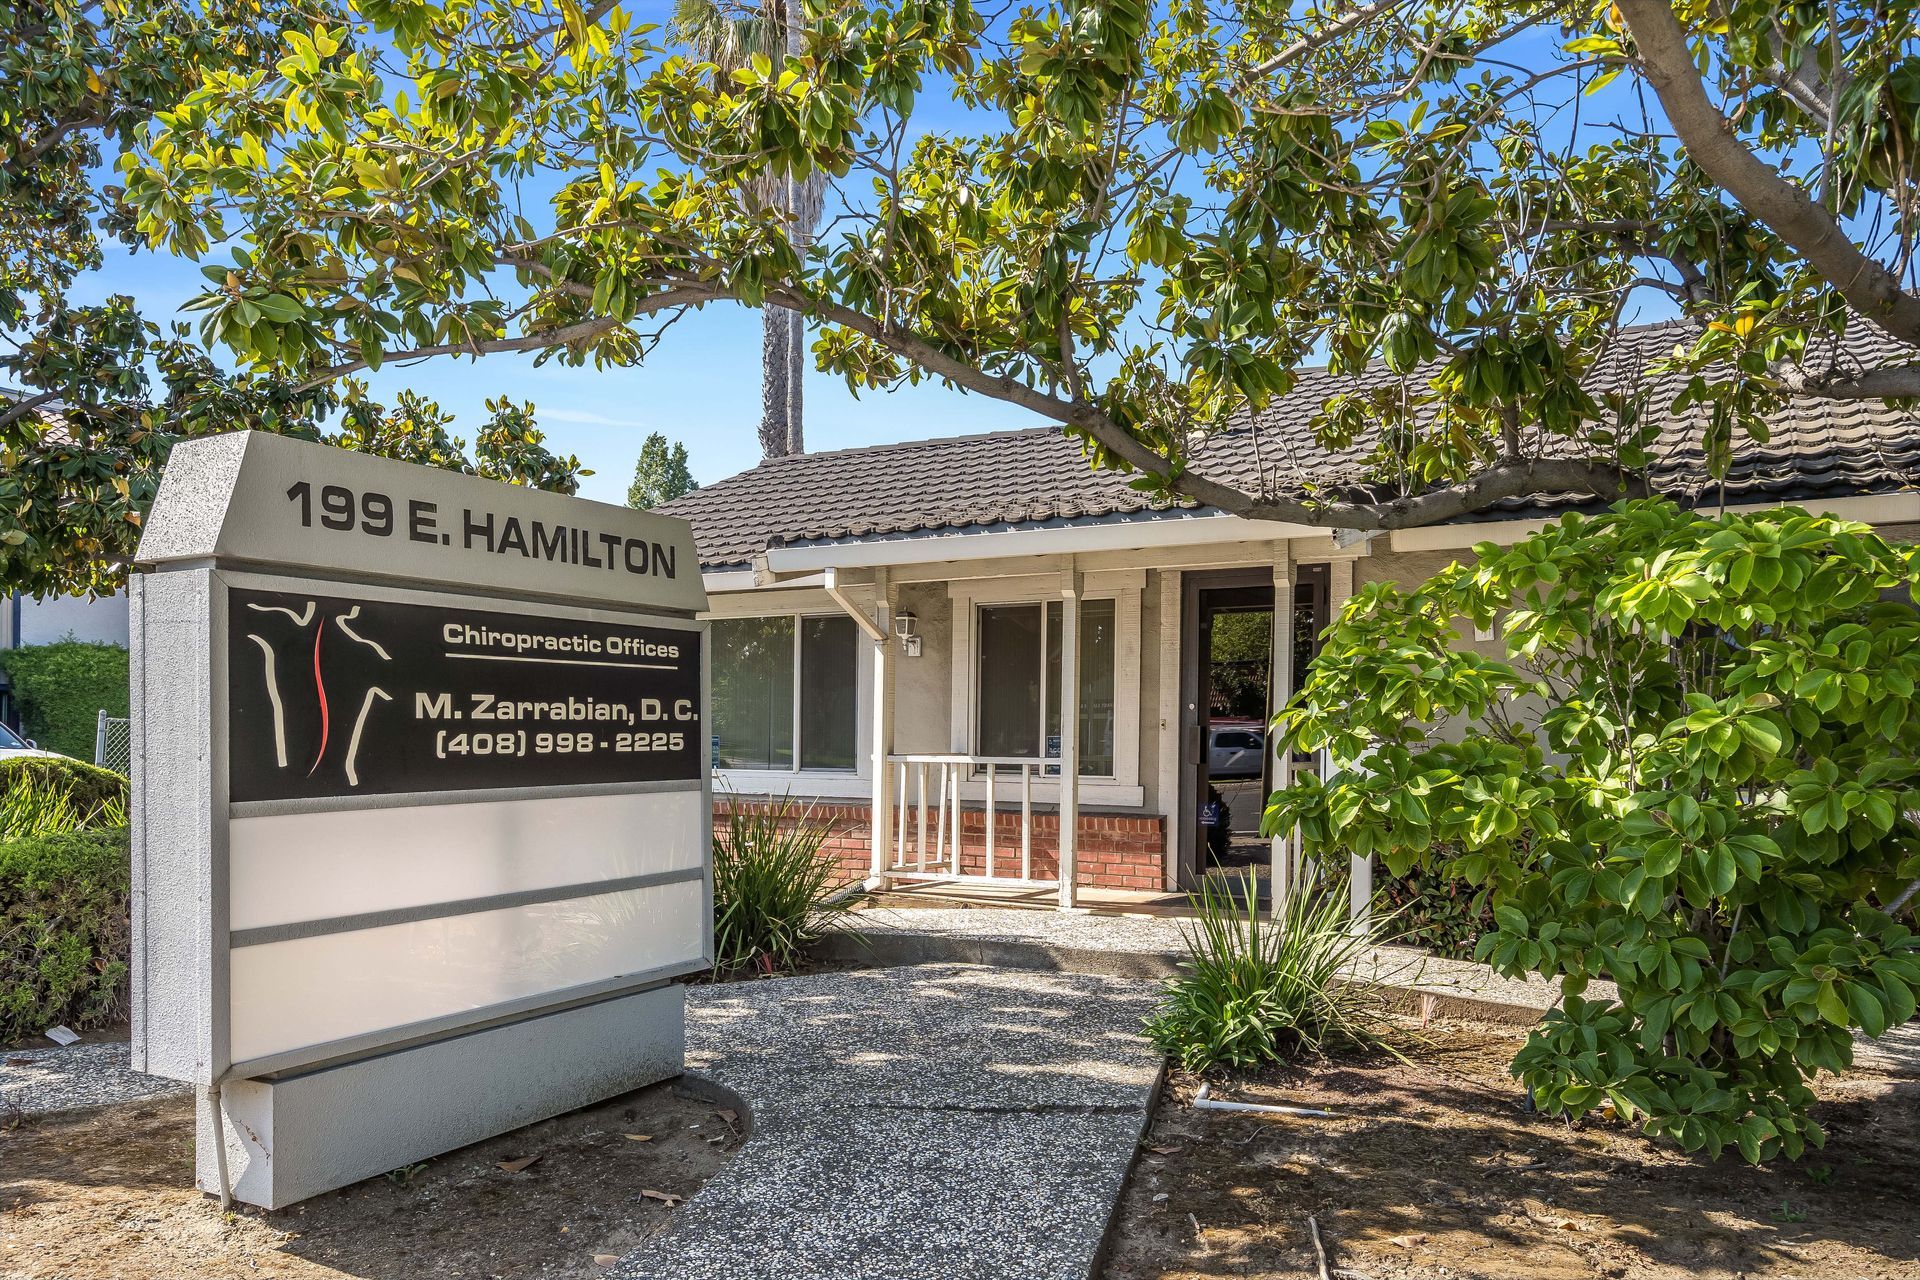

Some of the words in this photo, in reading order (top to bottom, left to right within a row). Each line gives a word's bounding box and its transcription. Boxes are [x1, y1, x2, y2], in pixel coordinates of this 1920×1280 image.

[286, 481, 394, 537] 199
[409, 499, 450, 546] E.
[463, 508, 676, 579] HAMILTON
[443, 623, 601, 652] Chiropractic
[606, 636, 679, 658] Offices
[415, 692, 462, 719] M.
[471, 694, 635, 726] Zarrabian,
[436, 730, 526, 759] (408)
